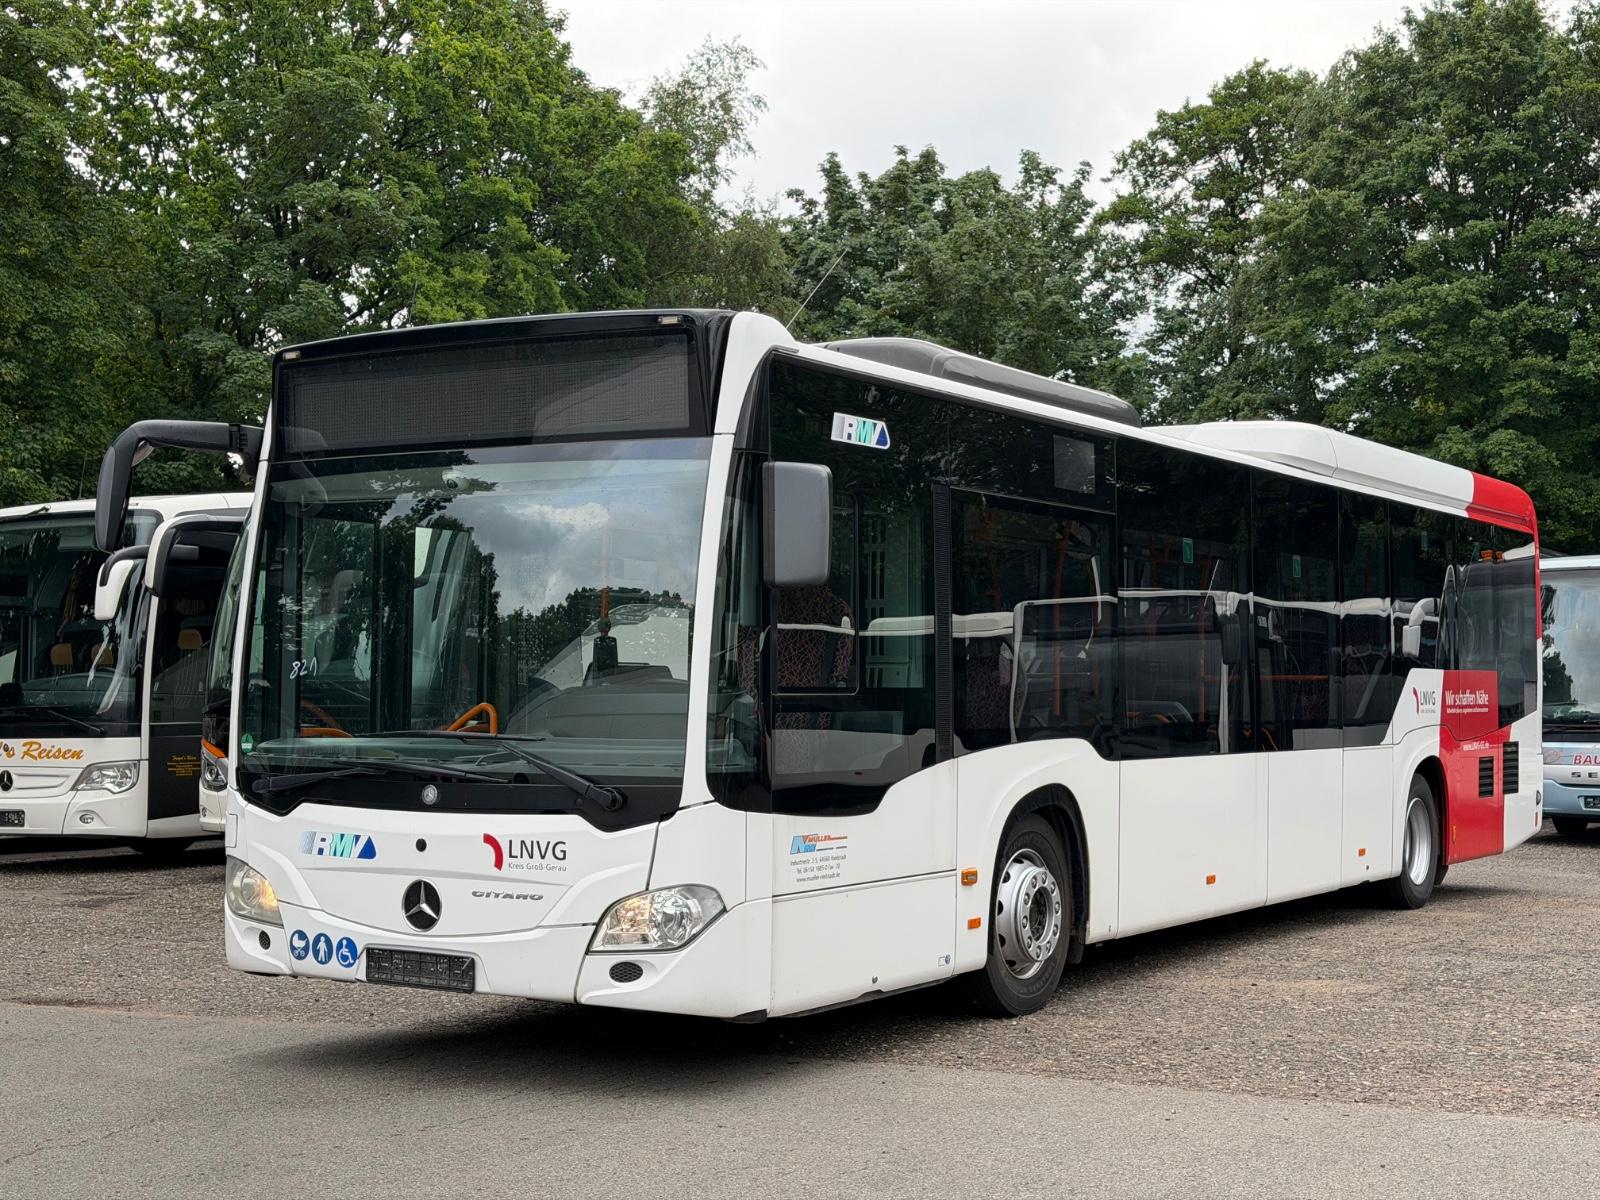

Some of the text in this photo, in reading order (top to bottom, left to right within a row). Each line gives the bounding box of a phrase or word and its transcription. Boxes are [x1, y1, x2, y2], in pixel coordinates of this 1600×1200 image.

[290, 657, 317, 680] 821
[1420, 690, 1436, 706] LNVG
[1445, 689, 1489, 706] Wir schaffen Nähe
[21, 741, 84, 761] Reisen
[508, 839, 567, 861] LNVG
[508, 863, 525, 871] Kreis
[471, 890, 544, 901] CITARO
